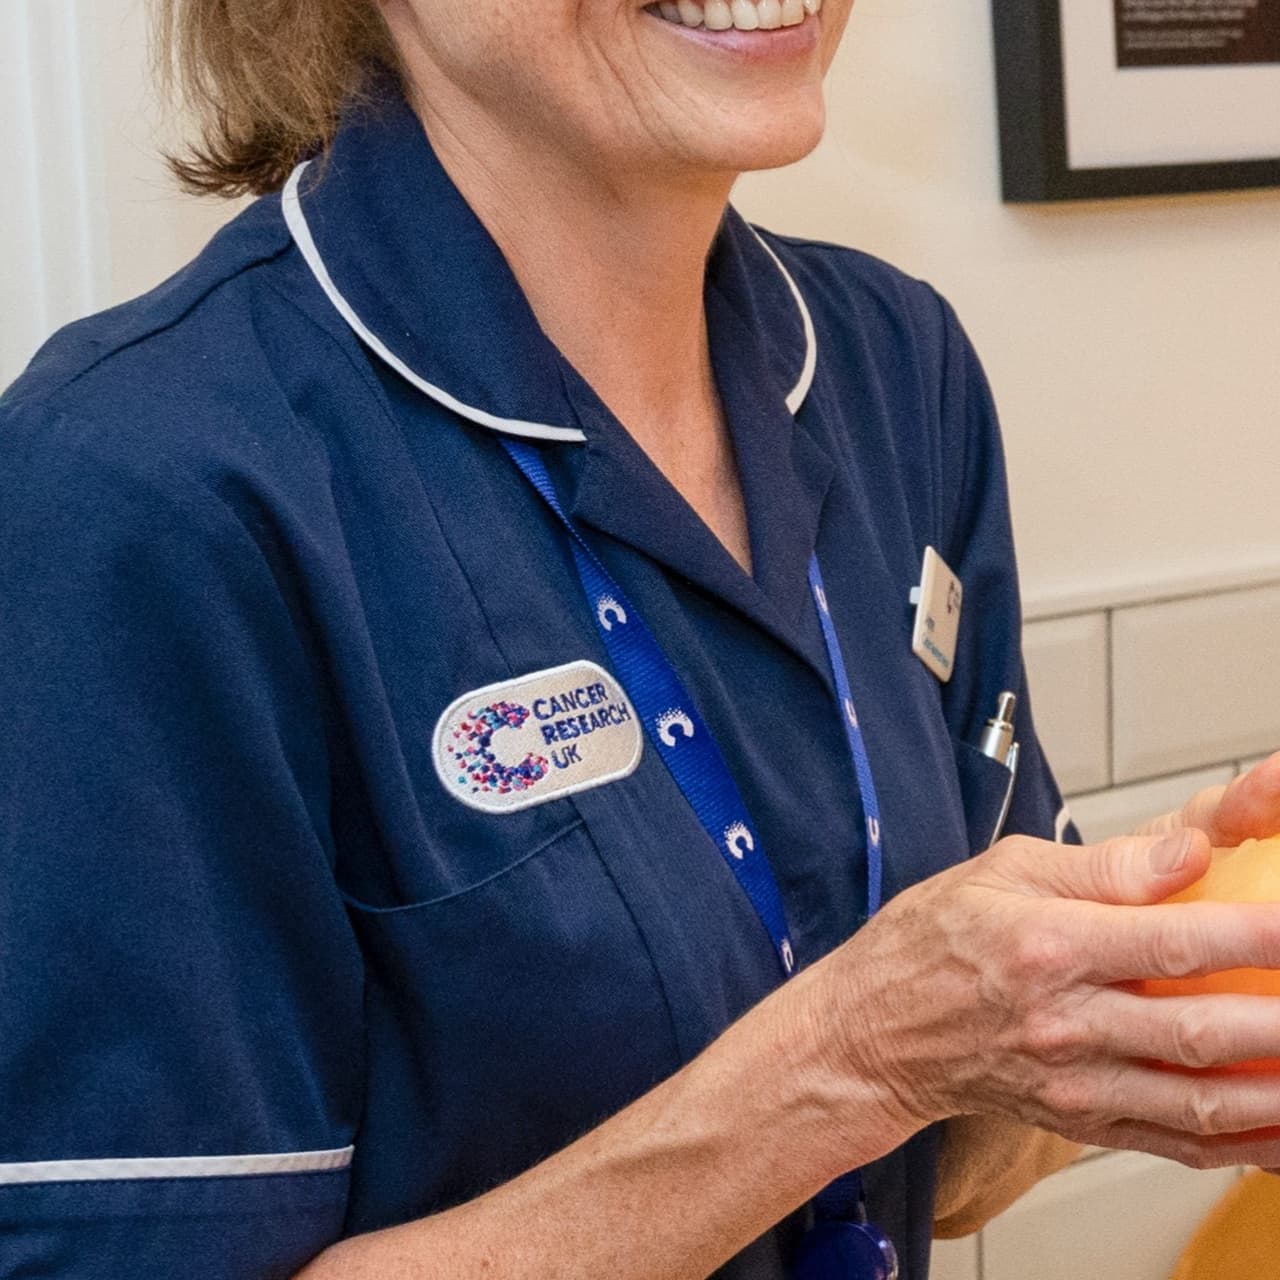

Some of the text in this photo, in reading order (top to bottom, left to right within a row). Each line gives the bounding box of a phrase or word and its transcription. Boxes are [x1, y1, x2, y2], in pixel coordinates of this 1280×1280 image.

[532, 683, 608, 720] CANCER
[540, 702, 632, 745] RESEARCH
[551, 745, 582, 769] UK
